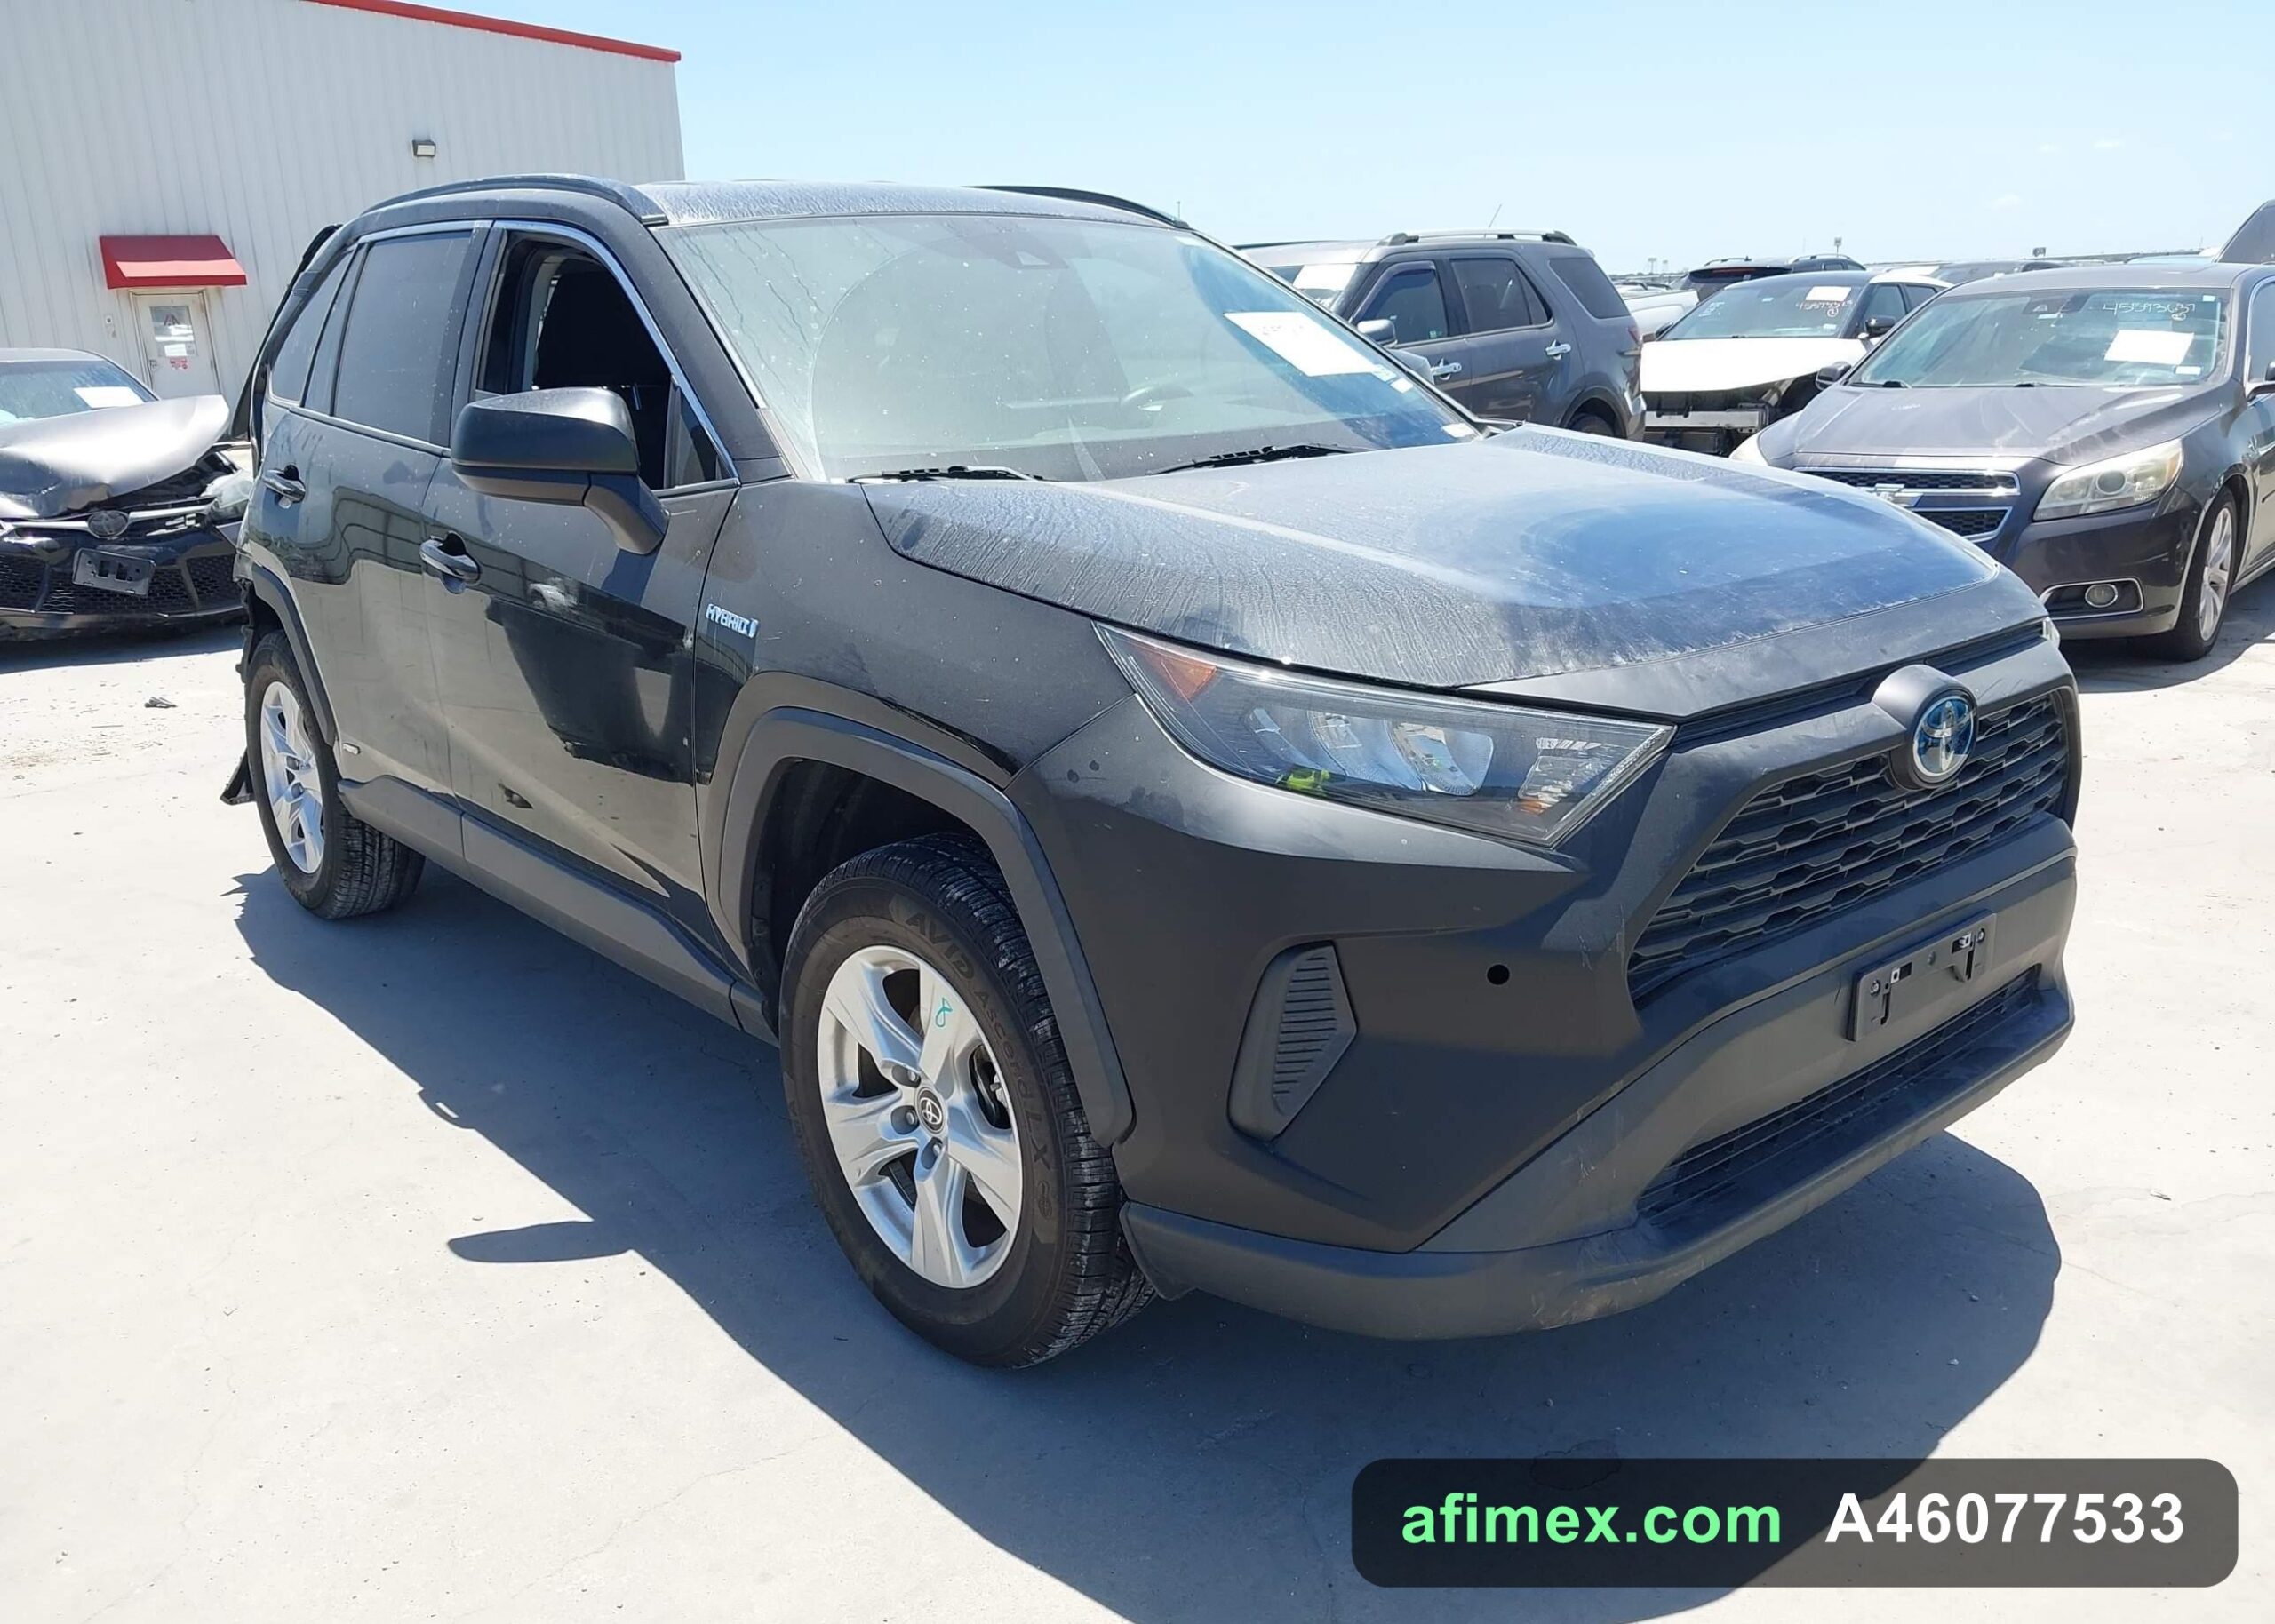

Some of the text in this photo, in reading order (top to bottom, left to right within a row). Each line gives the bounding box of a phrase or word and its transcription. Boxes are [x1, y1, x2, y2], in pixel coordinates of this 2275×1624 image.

[706, 603, 750, 636] HYBRID
[905, 912, 1051, 1172] AVID Ascend LX
